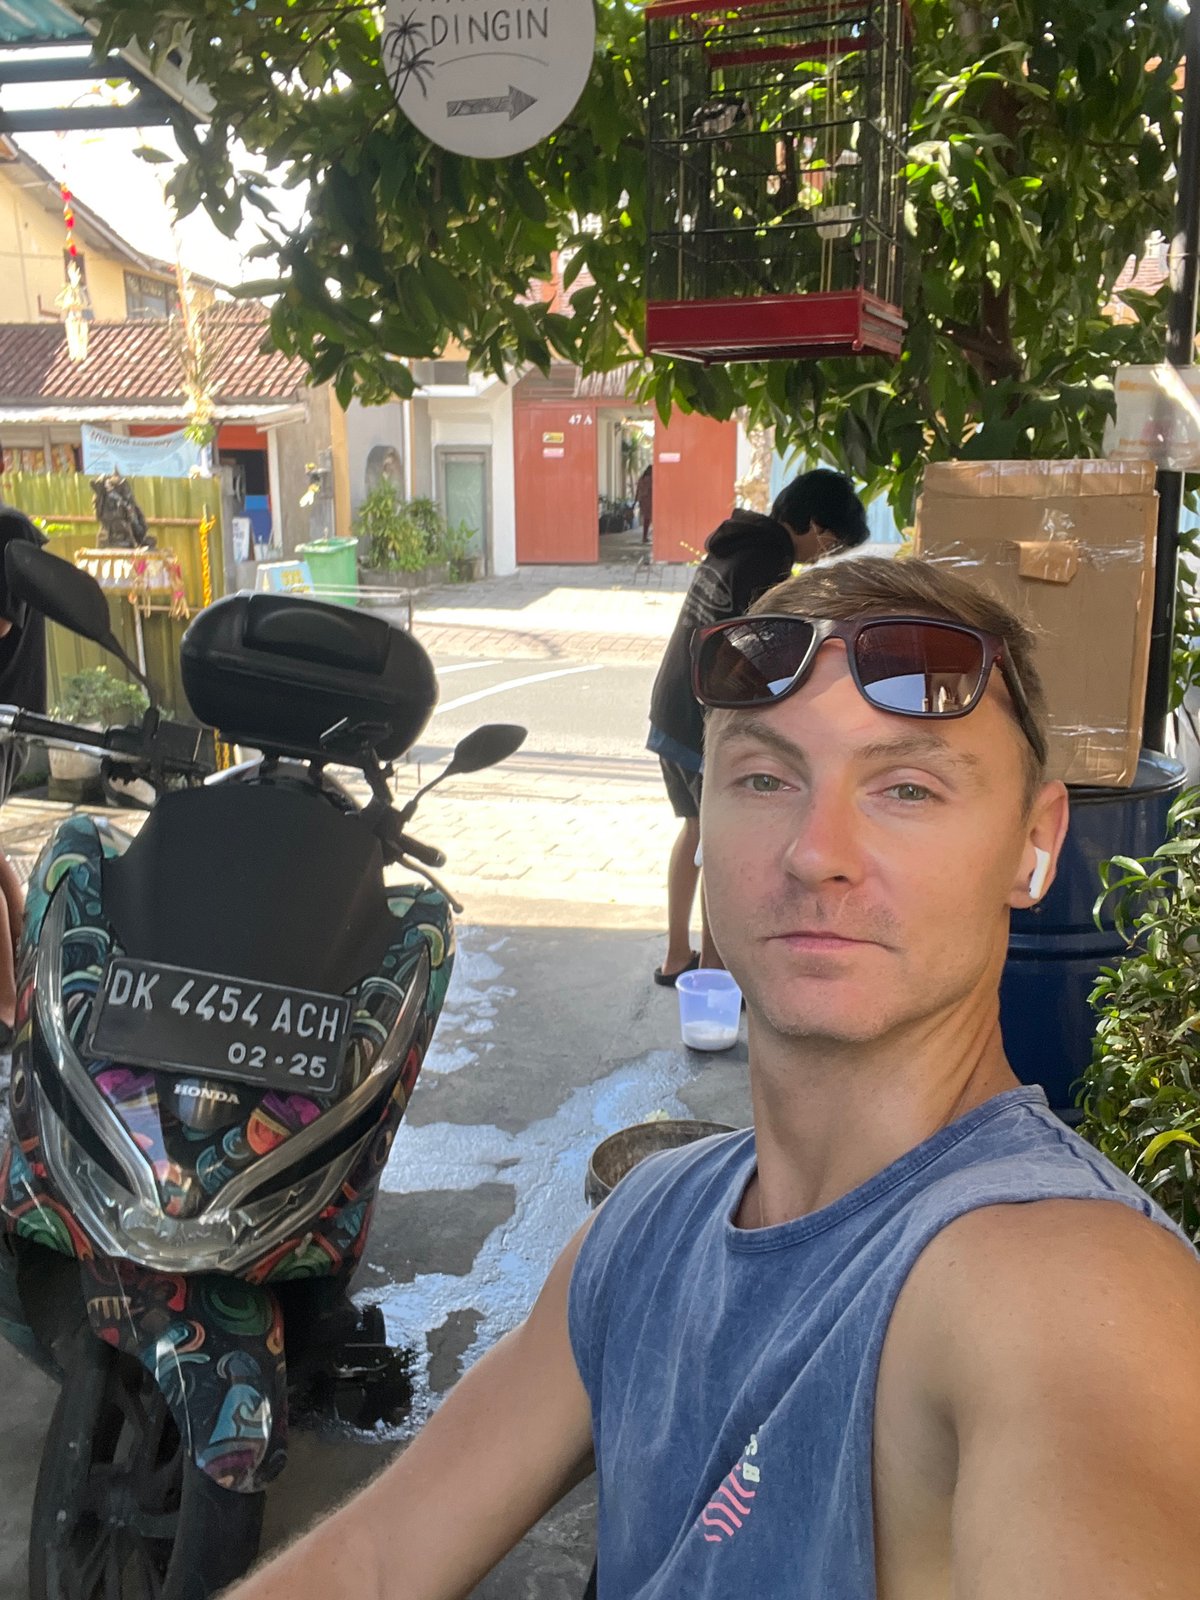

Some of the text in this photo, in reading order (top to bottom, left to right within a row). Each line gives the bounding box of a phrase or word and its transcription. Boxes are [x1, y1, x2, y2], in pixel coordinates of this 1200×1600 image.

[431, 7, 548, 47] DINGIN
[568, 413, 593, 425] 47 A
[108, 968, 340, 1043] DK 4454 ACH
[173, 1083, 240, 1105] HONDA
